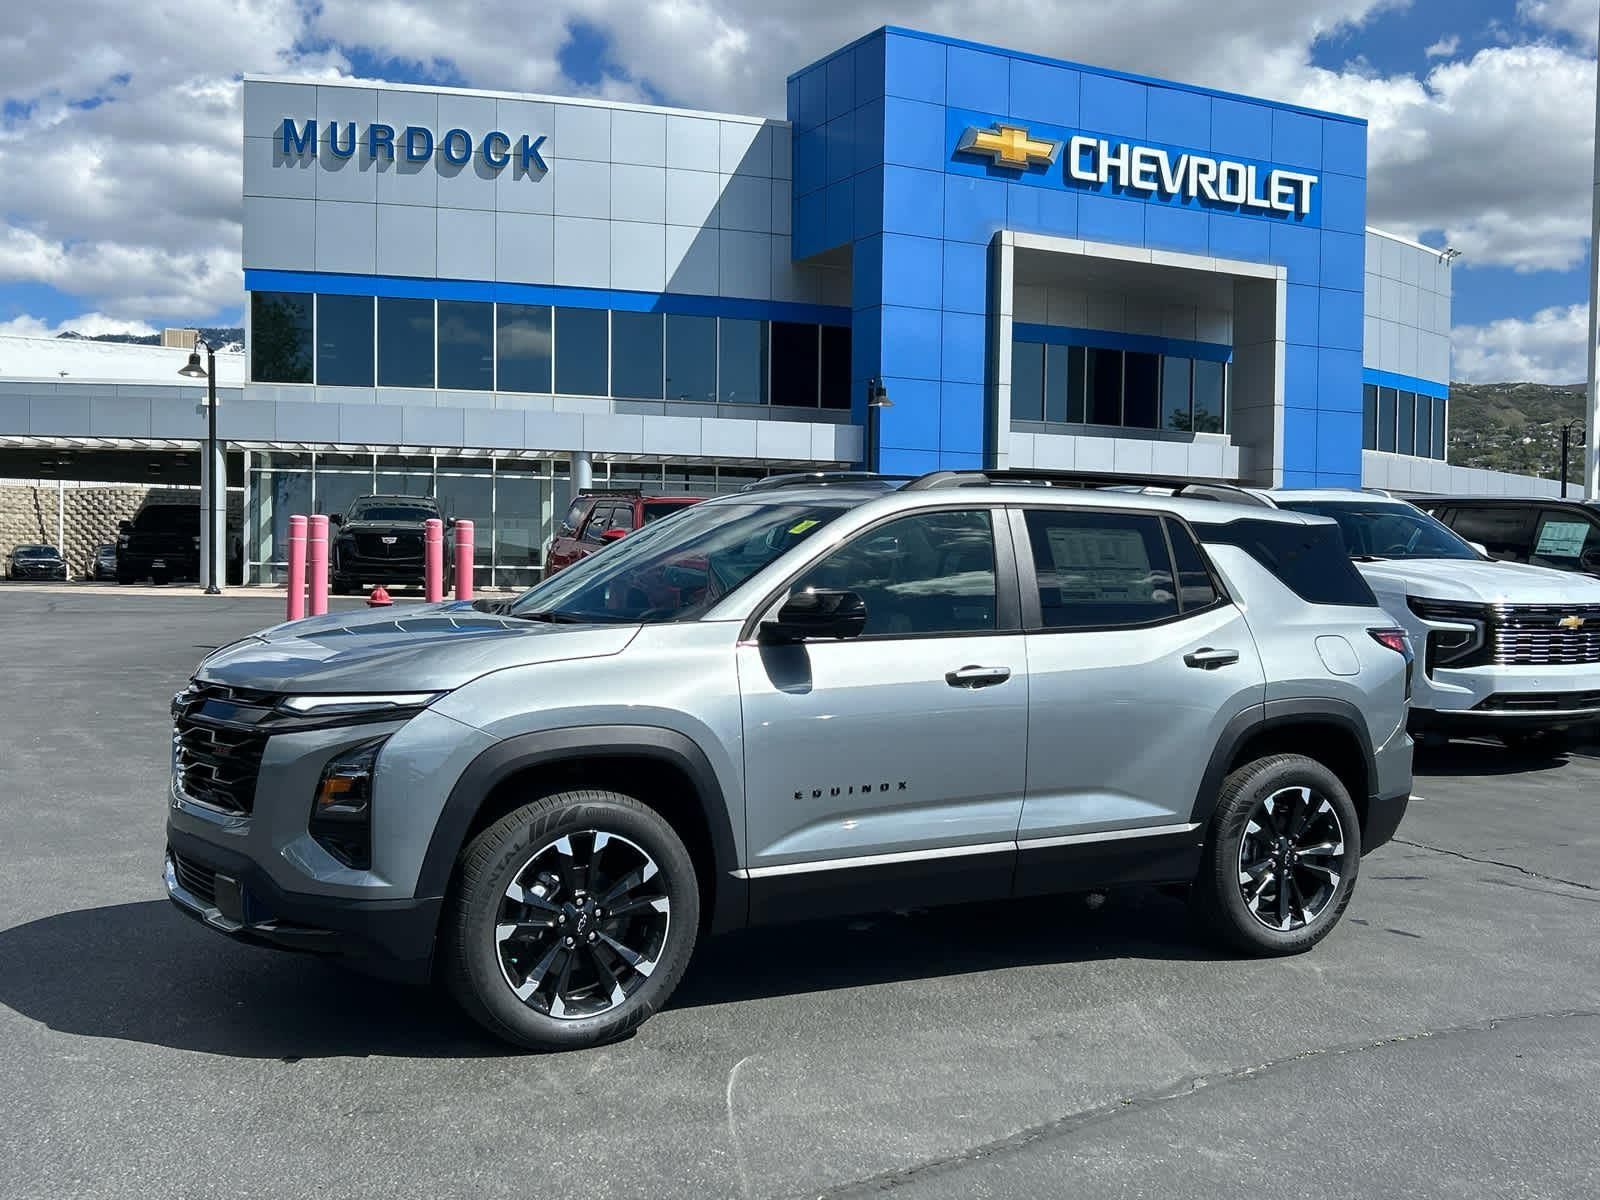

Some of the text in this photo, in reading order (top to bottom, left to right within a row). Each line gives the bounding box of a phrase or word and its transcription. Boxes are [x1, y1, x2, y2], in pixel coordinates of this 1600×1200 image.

[282, 117, 549, 174] MURDOCK
[1069, 135, 1319, 215] CHEVROLET
[794, 781, 907, 801] EQUINOX
